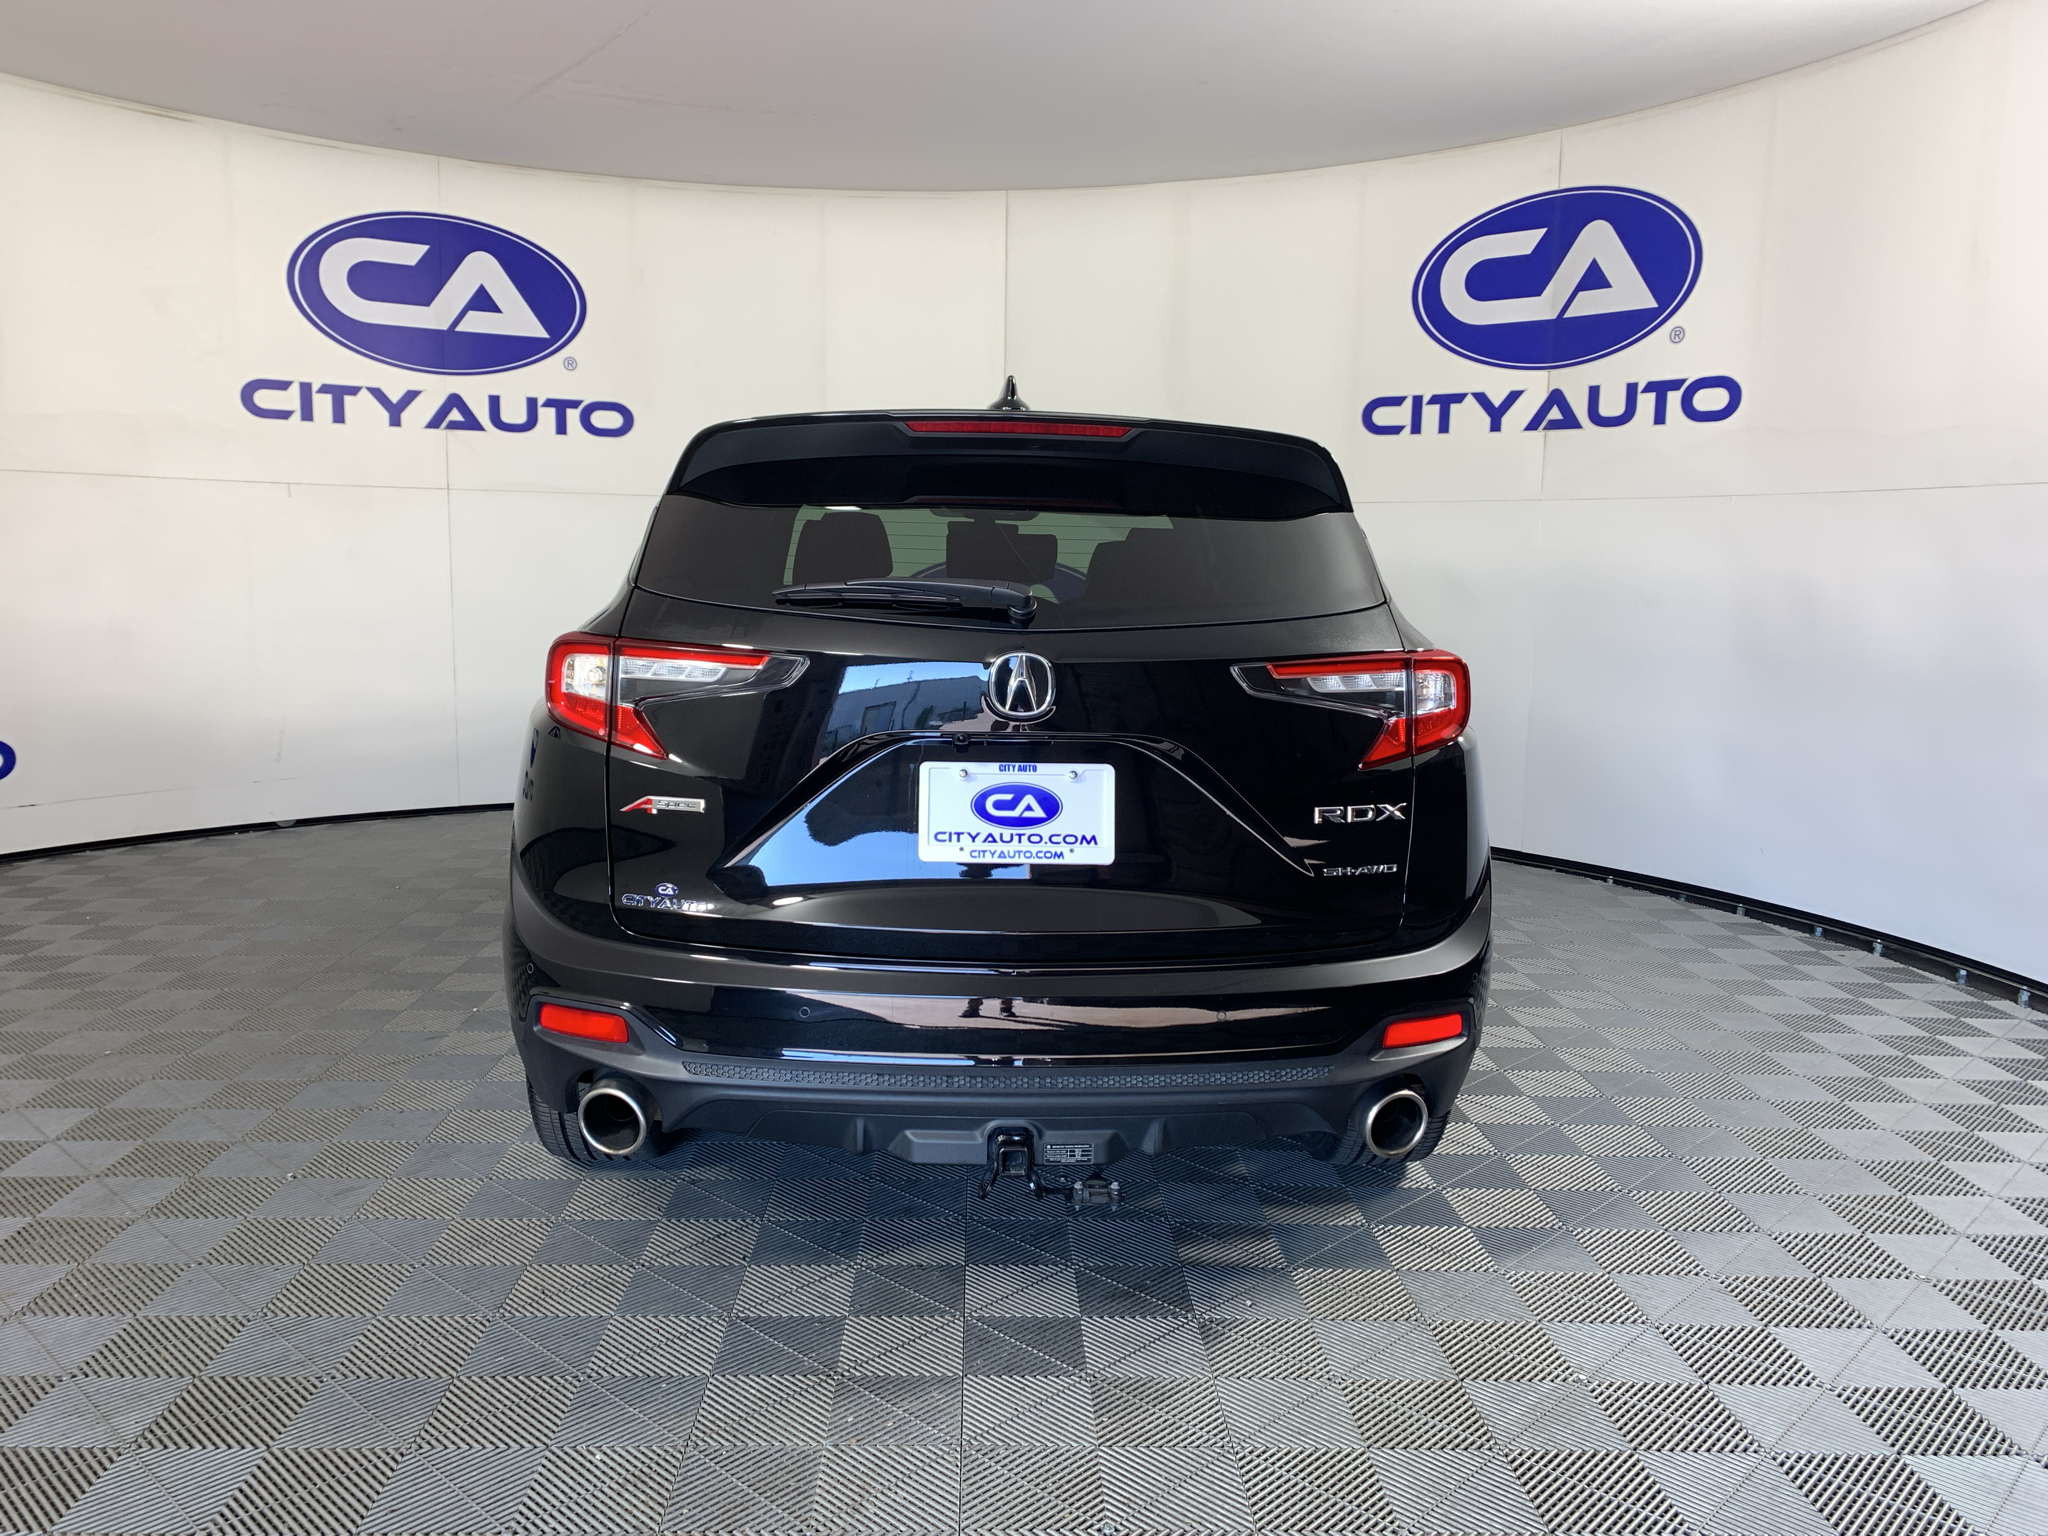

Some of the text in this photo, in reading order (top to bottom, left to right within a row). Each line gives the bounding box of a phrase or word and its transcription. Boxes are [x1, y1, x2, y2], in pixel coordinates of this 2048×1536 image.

[1440, 219, 1659, 326] CA
[318, 237, 551, 339] CA
[998, 763, 1038, 773] CITY AUTO
[985, 793, 1048, 818] CA
[1314, 802, 1407, 825] RDX
[933, 831, 1098, 846] CITYAUTO.COM
[969, 849, 1065, 860] CITYAUTO.COM
[1323, 864, 1398, 877] SH-AWD
